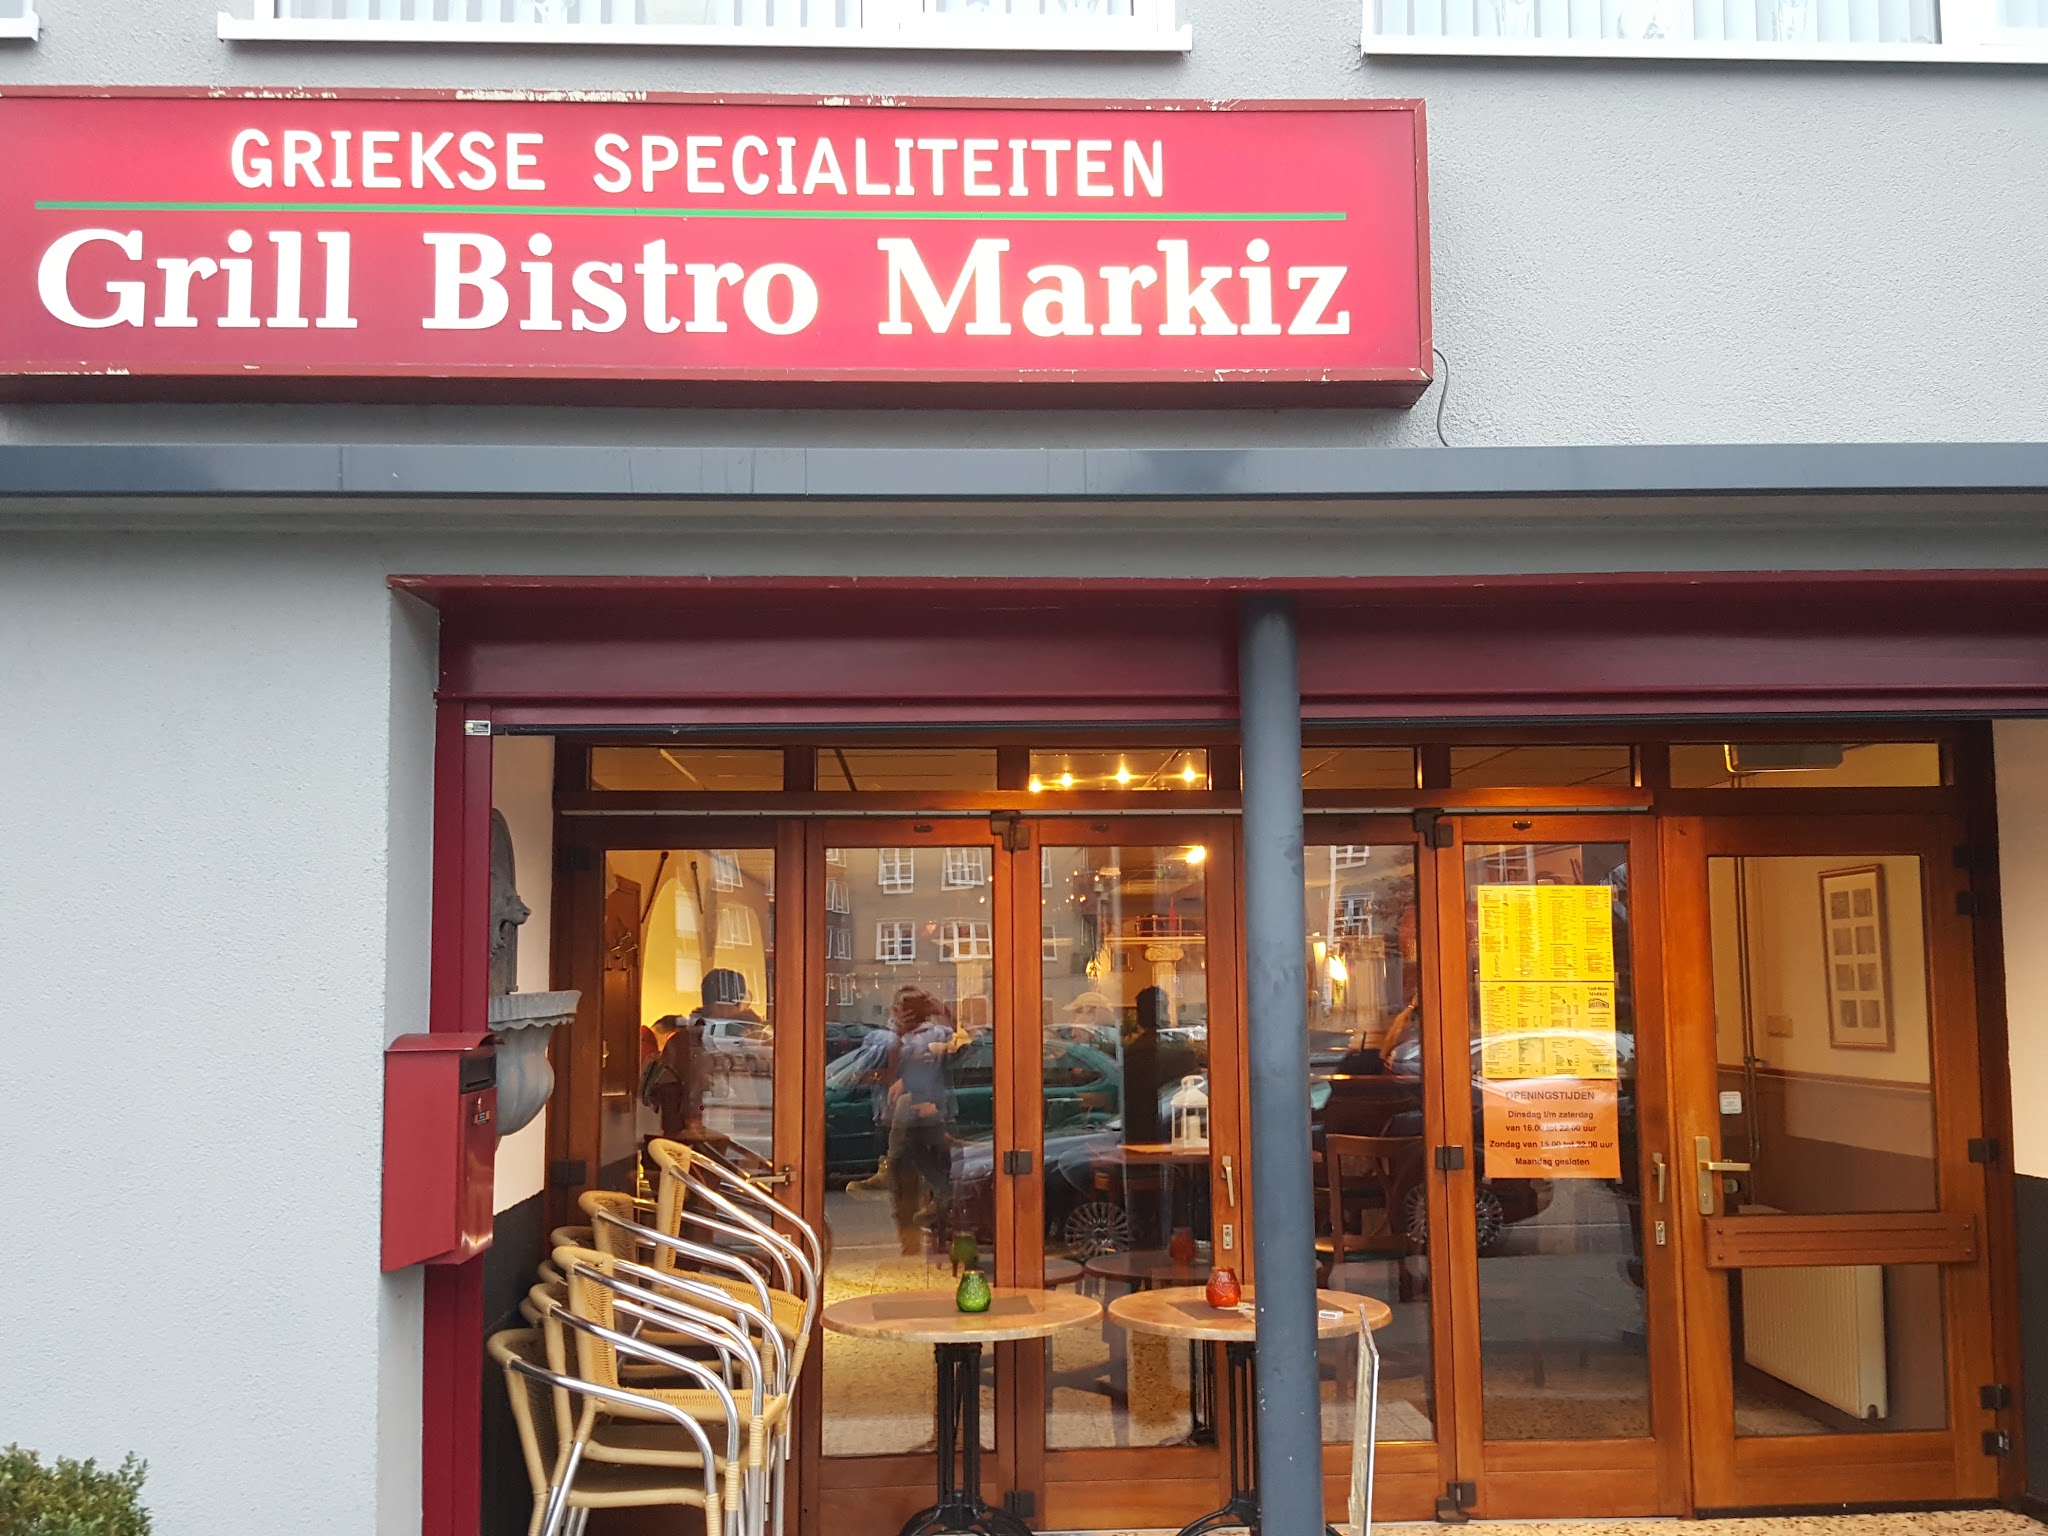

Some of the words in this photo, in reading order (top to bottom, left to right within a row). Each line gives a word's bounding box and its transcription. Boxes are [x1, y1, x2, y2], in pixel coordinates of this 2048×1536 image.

[231, 129, 546, 191] GRIEKSE
[593, 134, 1164, 198] SPECIALITEITEN
[37, 228, 358, 329] Grill
[421, 232, 819, 335] Bistro
[877, 237, 1351, 337] Markiz
[1505, 1091, 1595, 1100] OPENINGSTIJDEN
[1508, 1110, 1541, 1120] Dinsdag
[1558, 1110, 1594, 1120] zaterdag
[1489, 1140, 1521, 1150] Zondag
[1515, 1157, 1553, 1167] Maandag
[1555, 1157, 1590, 1167] gesloten
